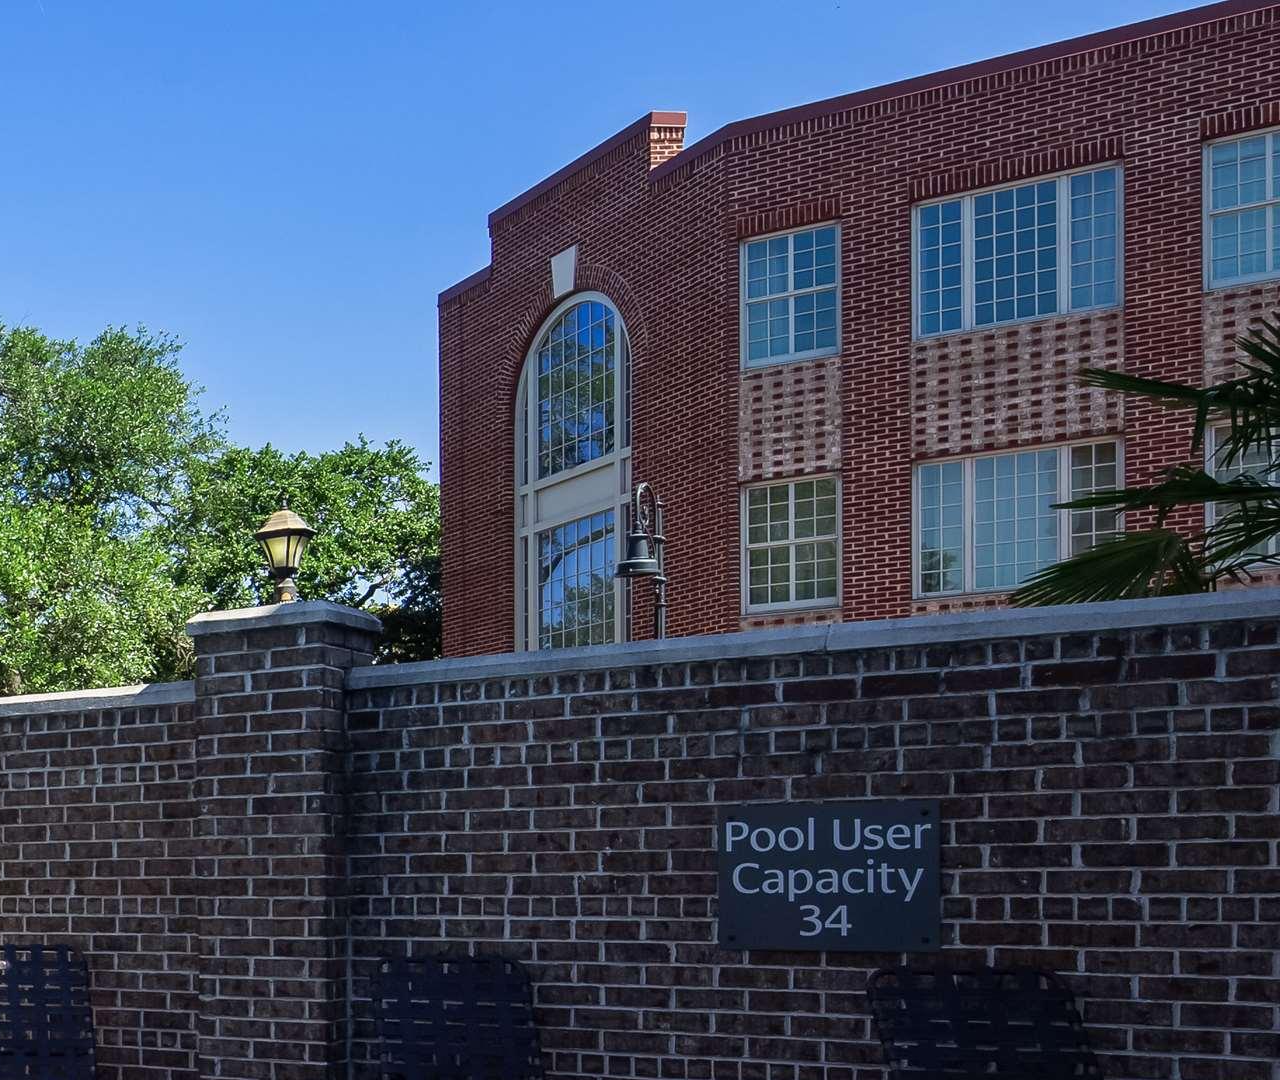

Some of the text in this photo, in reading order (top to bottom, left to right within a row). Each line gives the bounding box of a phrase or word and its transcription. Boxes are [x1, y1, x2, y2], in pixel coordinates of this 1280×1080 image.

[725, 817, 932, 852] Pool User
[732, 858, 925, 902] Capacity
[799, 904, 853, 937] 34
